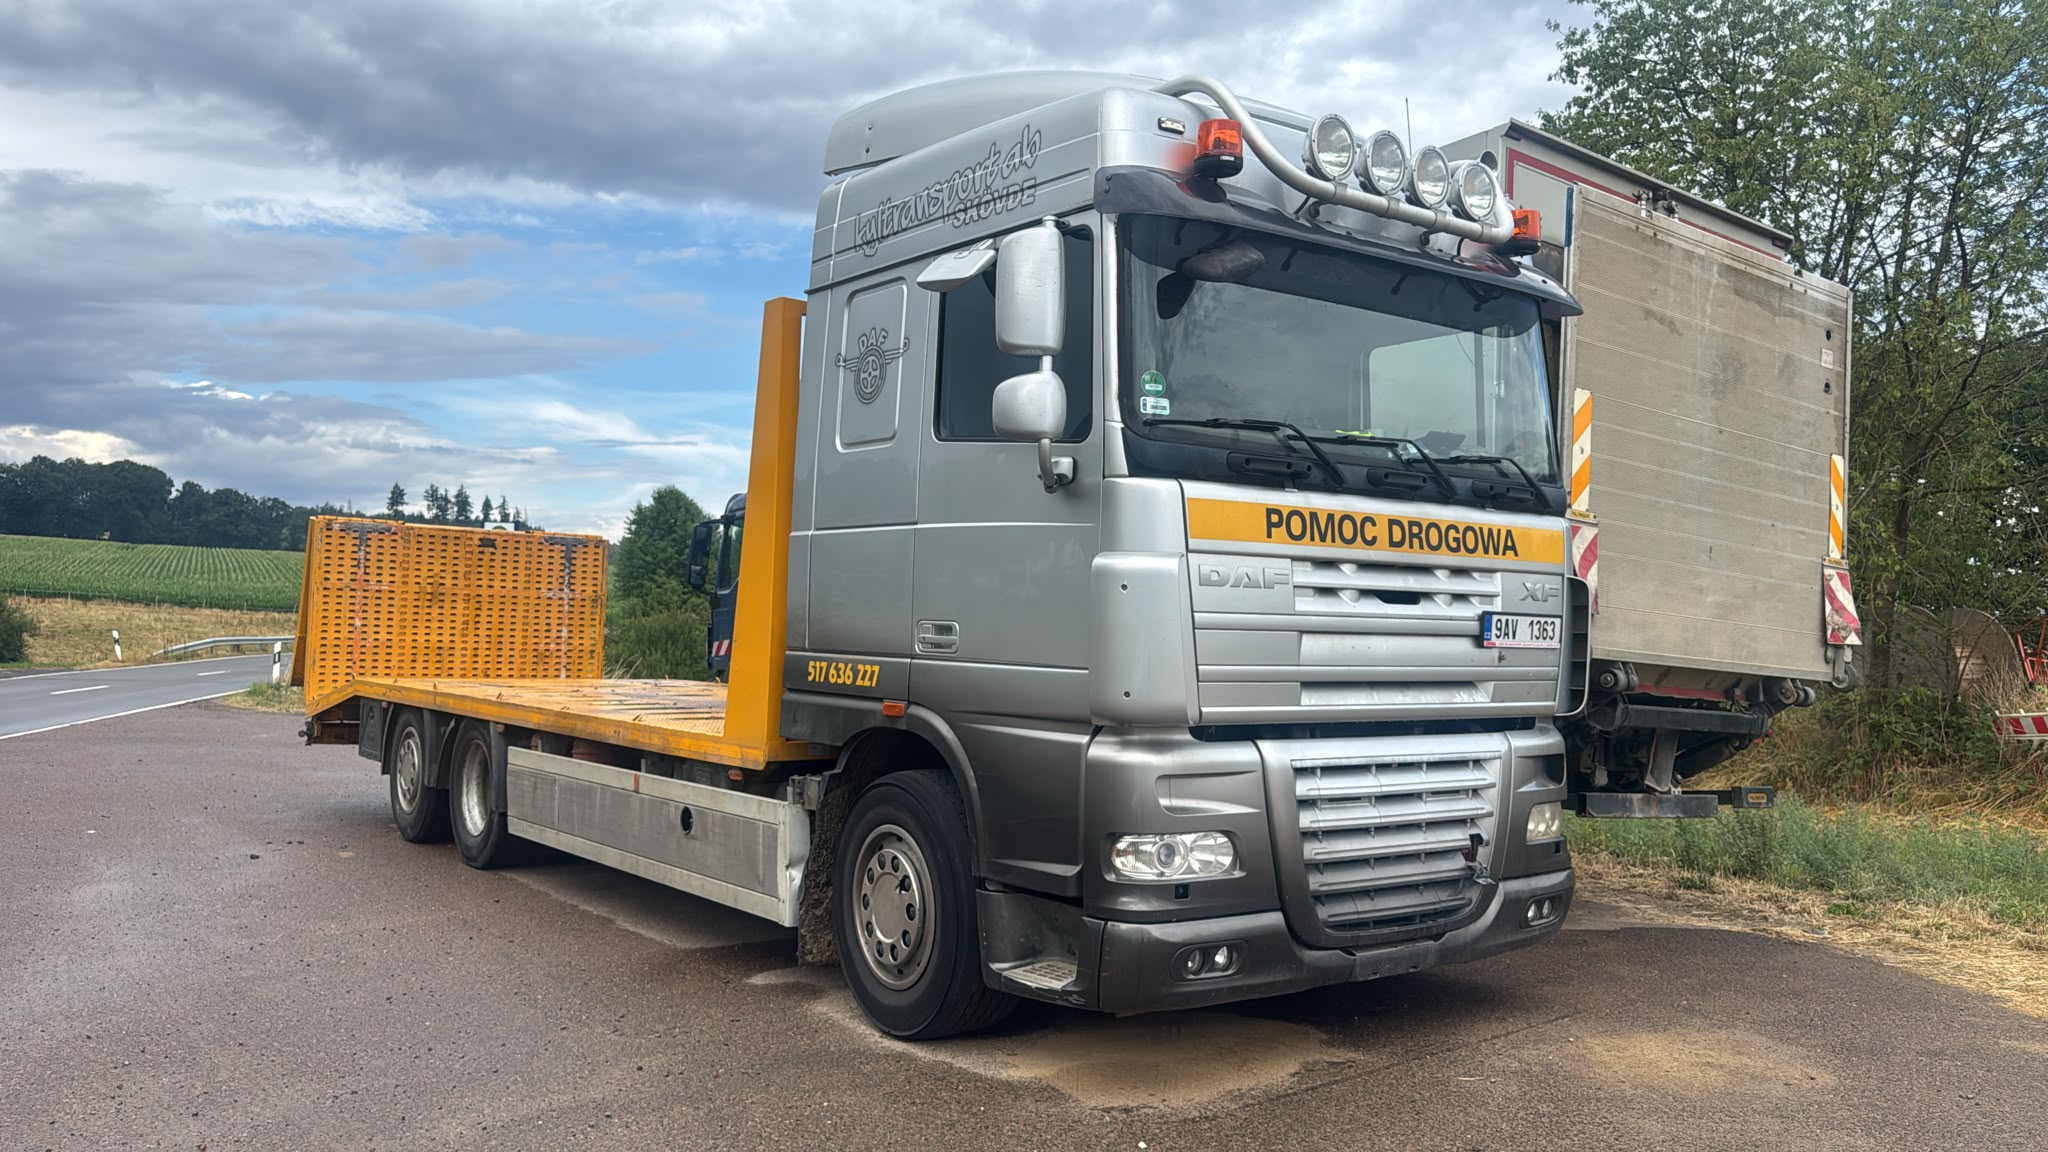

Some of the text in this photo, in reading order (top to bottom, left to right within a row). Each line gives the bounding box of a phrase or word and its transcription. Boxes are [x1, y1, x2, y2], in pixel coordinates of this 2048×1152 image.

[1000, 123, 1042, 180] ab
[951, 177, 1037, 229] SKÖVDE
[858, 327, 889, 355] DAF
[1265, 507, 1520, 558] POMOC DROGOWA
[1199, 563, 1561, 602] DAF XF
[1494, 618, 1556, 641] 9AV 1363
[807, 660, 880, 687] 517 636 227
